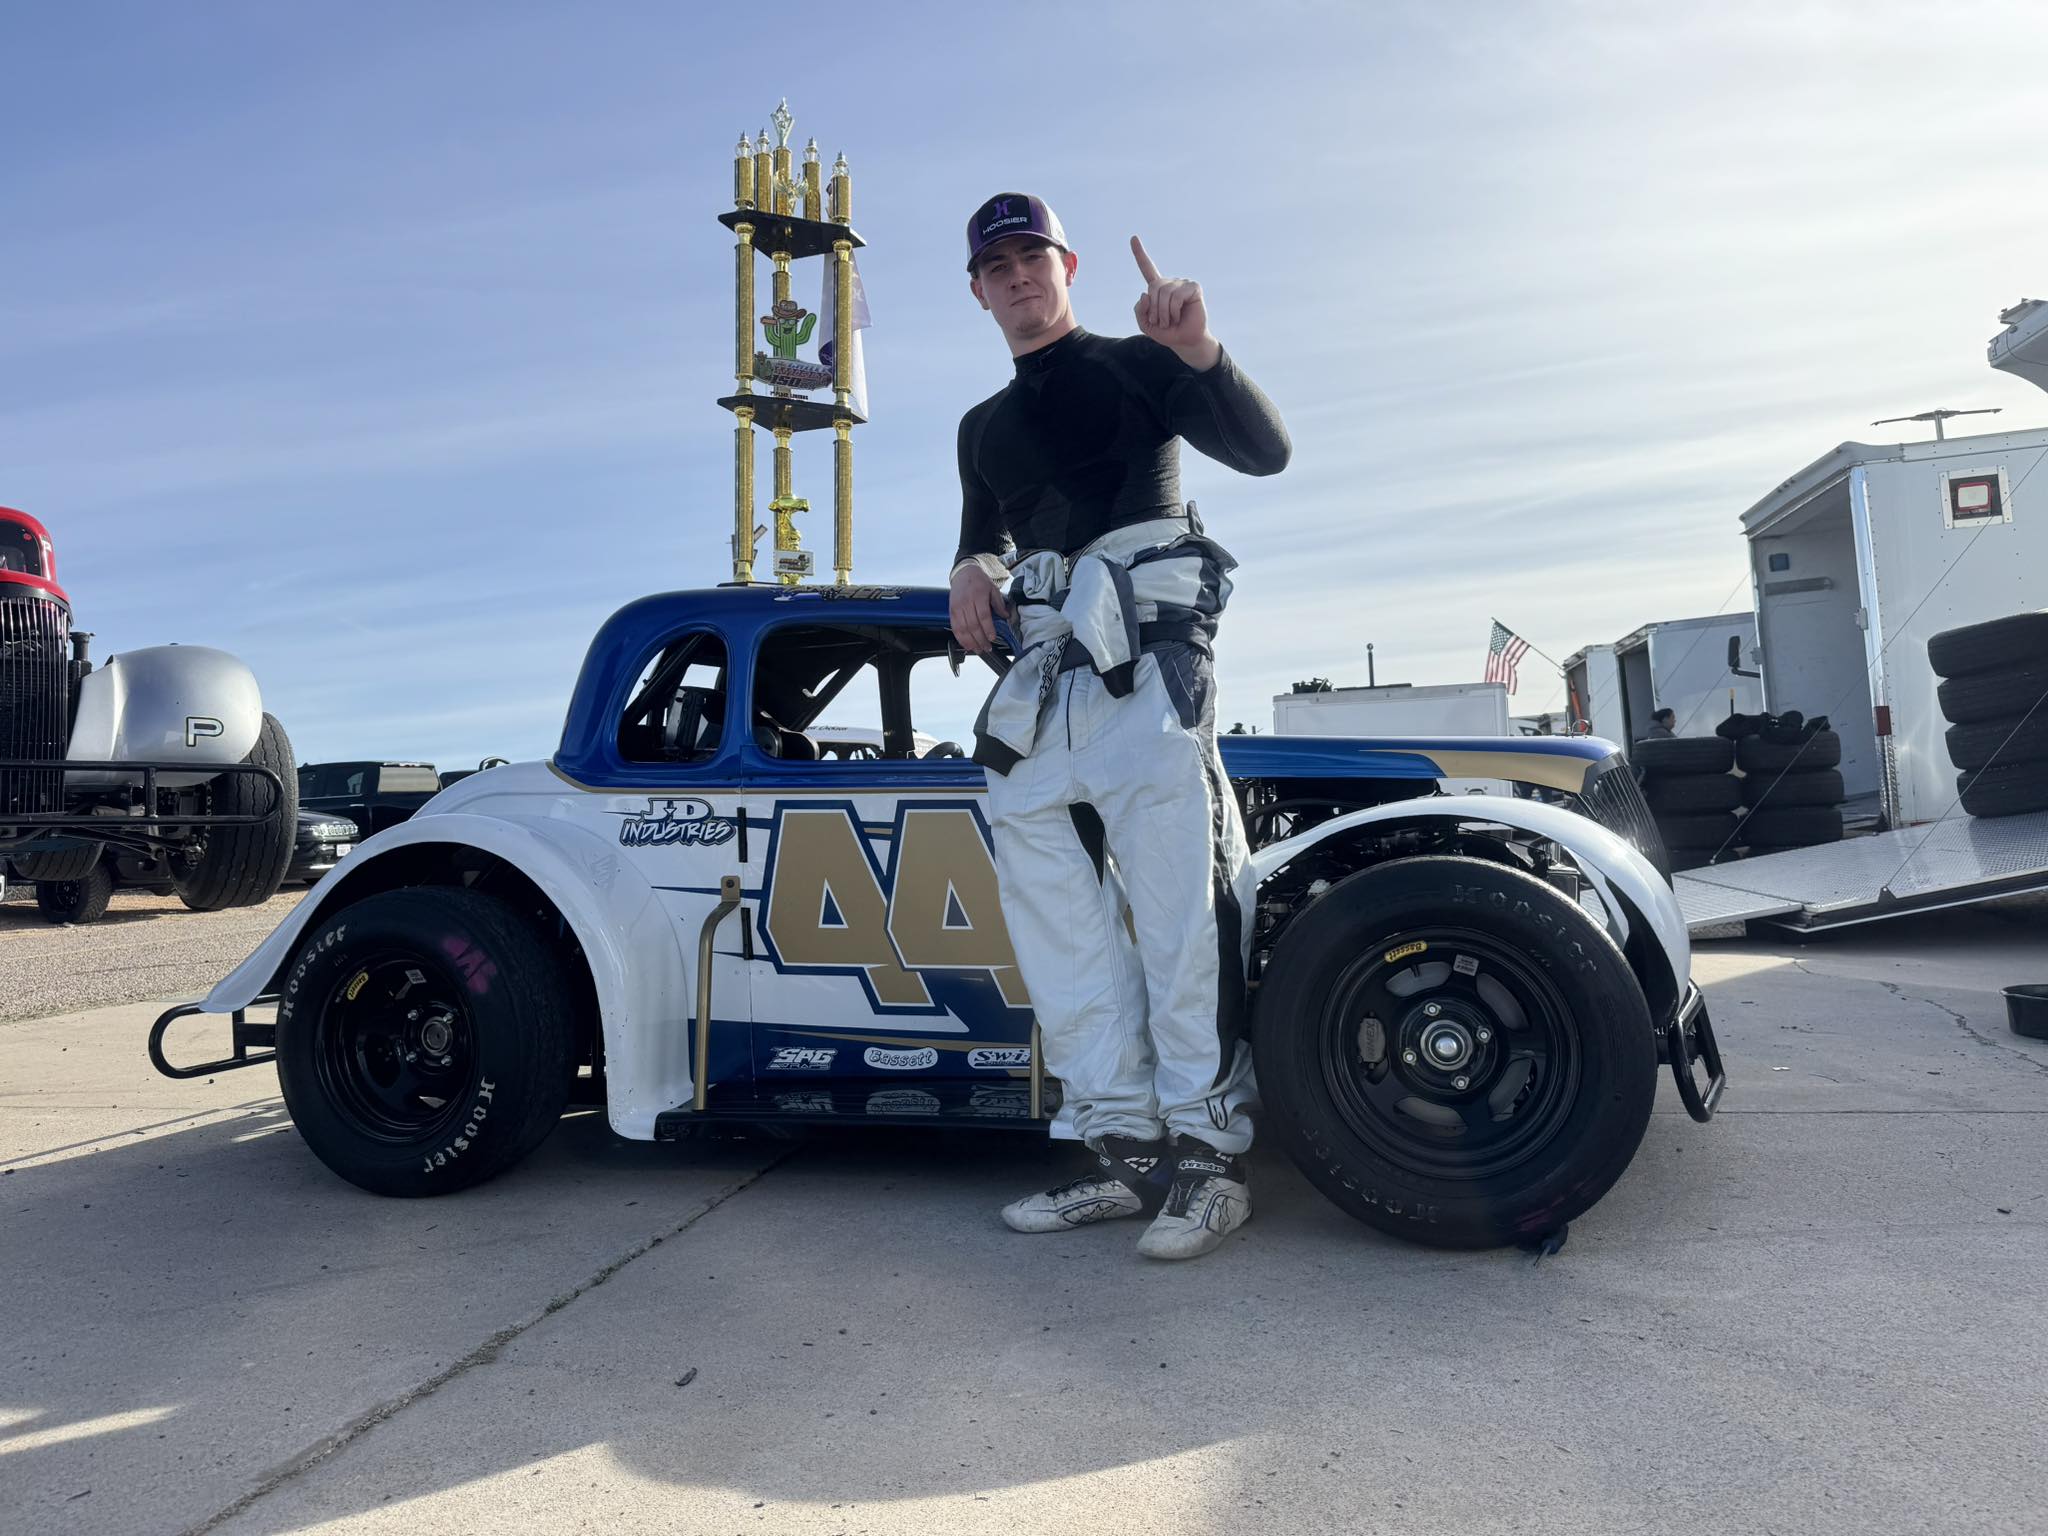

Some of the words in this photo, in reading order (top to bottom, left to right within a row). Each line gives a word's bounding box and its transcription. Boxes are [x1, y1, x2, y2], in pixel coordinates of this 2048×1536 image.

[982, 216, 1028, 236] HOOSIER
[186, 717, 224, 747] P
[621, 819, 734, 844] INDUSTRIES
[766, 808, 1038, 1009] 44
[281, 924, 347, 1021] Hoosier
[774, 1048, 836, 1063] SAG
[869, 1050, 933, 1067] Bassett
[424, 1076, 495, 1172] Hoosier
